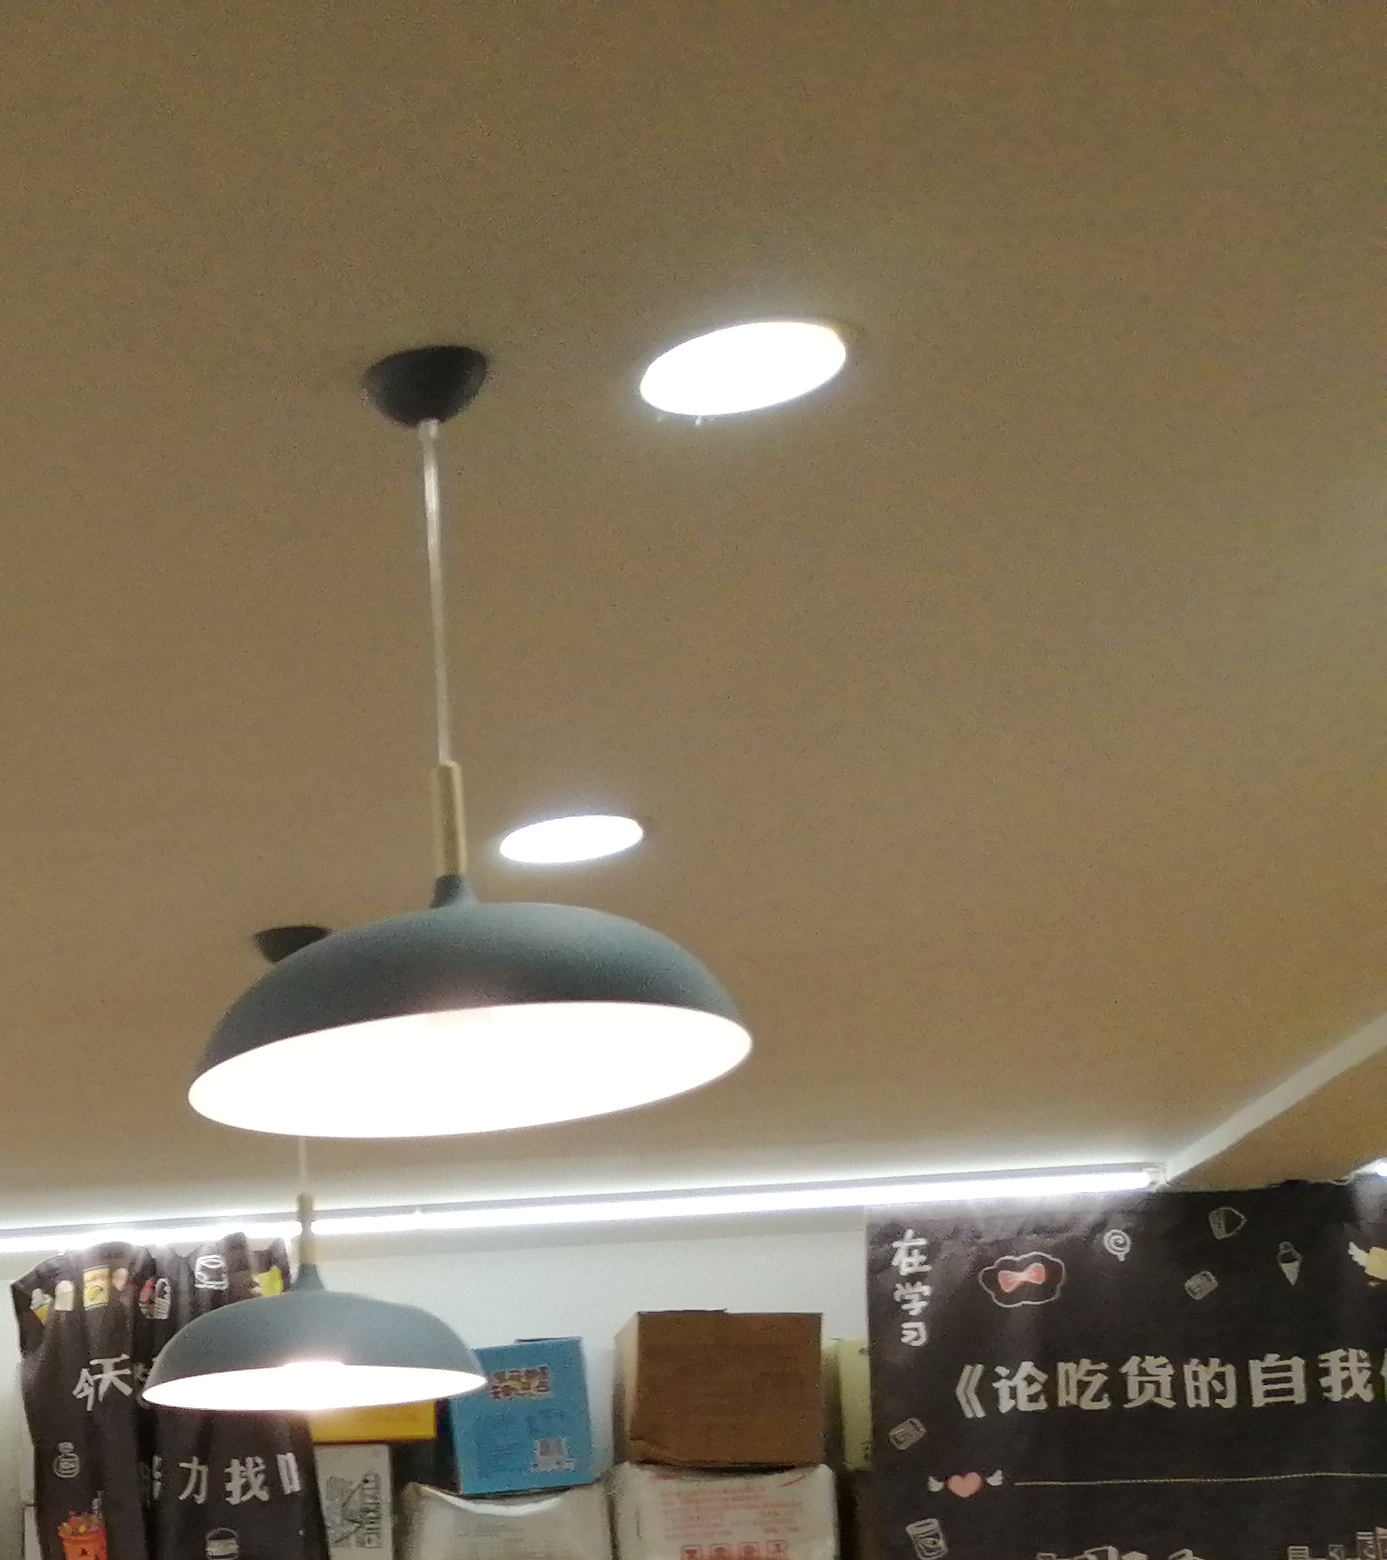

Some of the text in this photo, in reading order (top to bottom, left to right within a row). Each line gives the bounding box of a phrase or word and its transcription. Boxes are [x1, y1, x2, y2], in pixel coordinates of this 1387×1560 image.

[954, 1347, 1387, 1419] 《论吃货的自我
